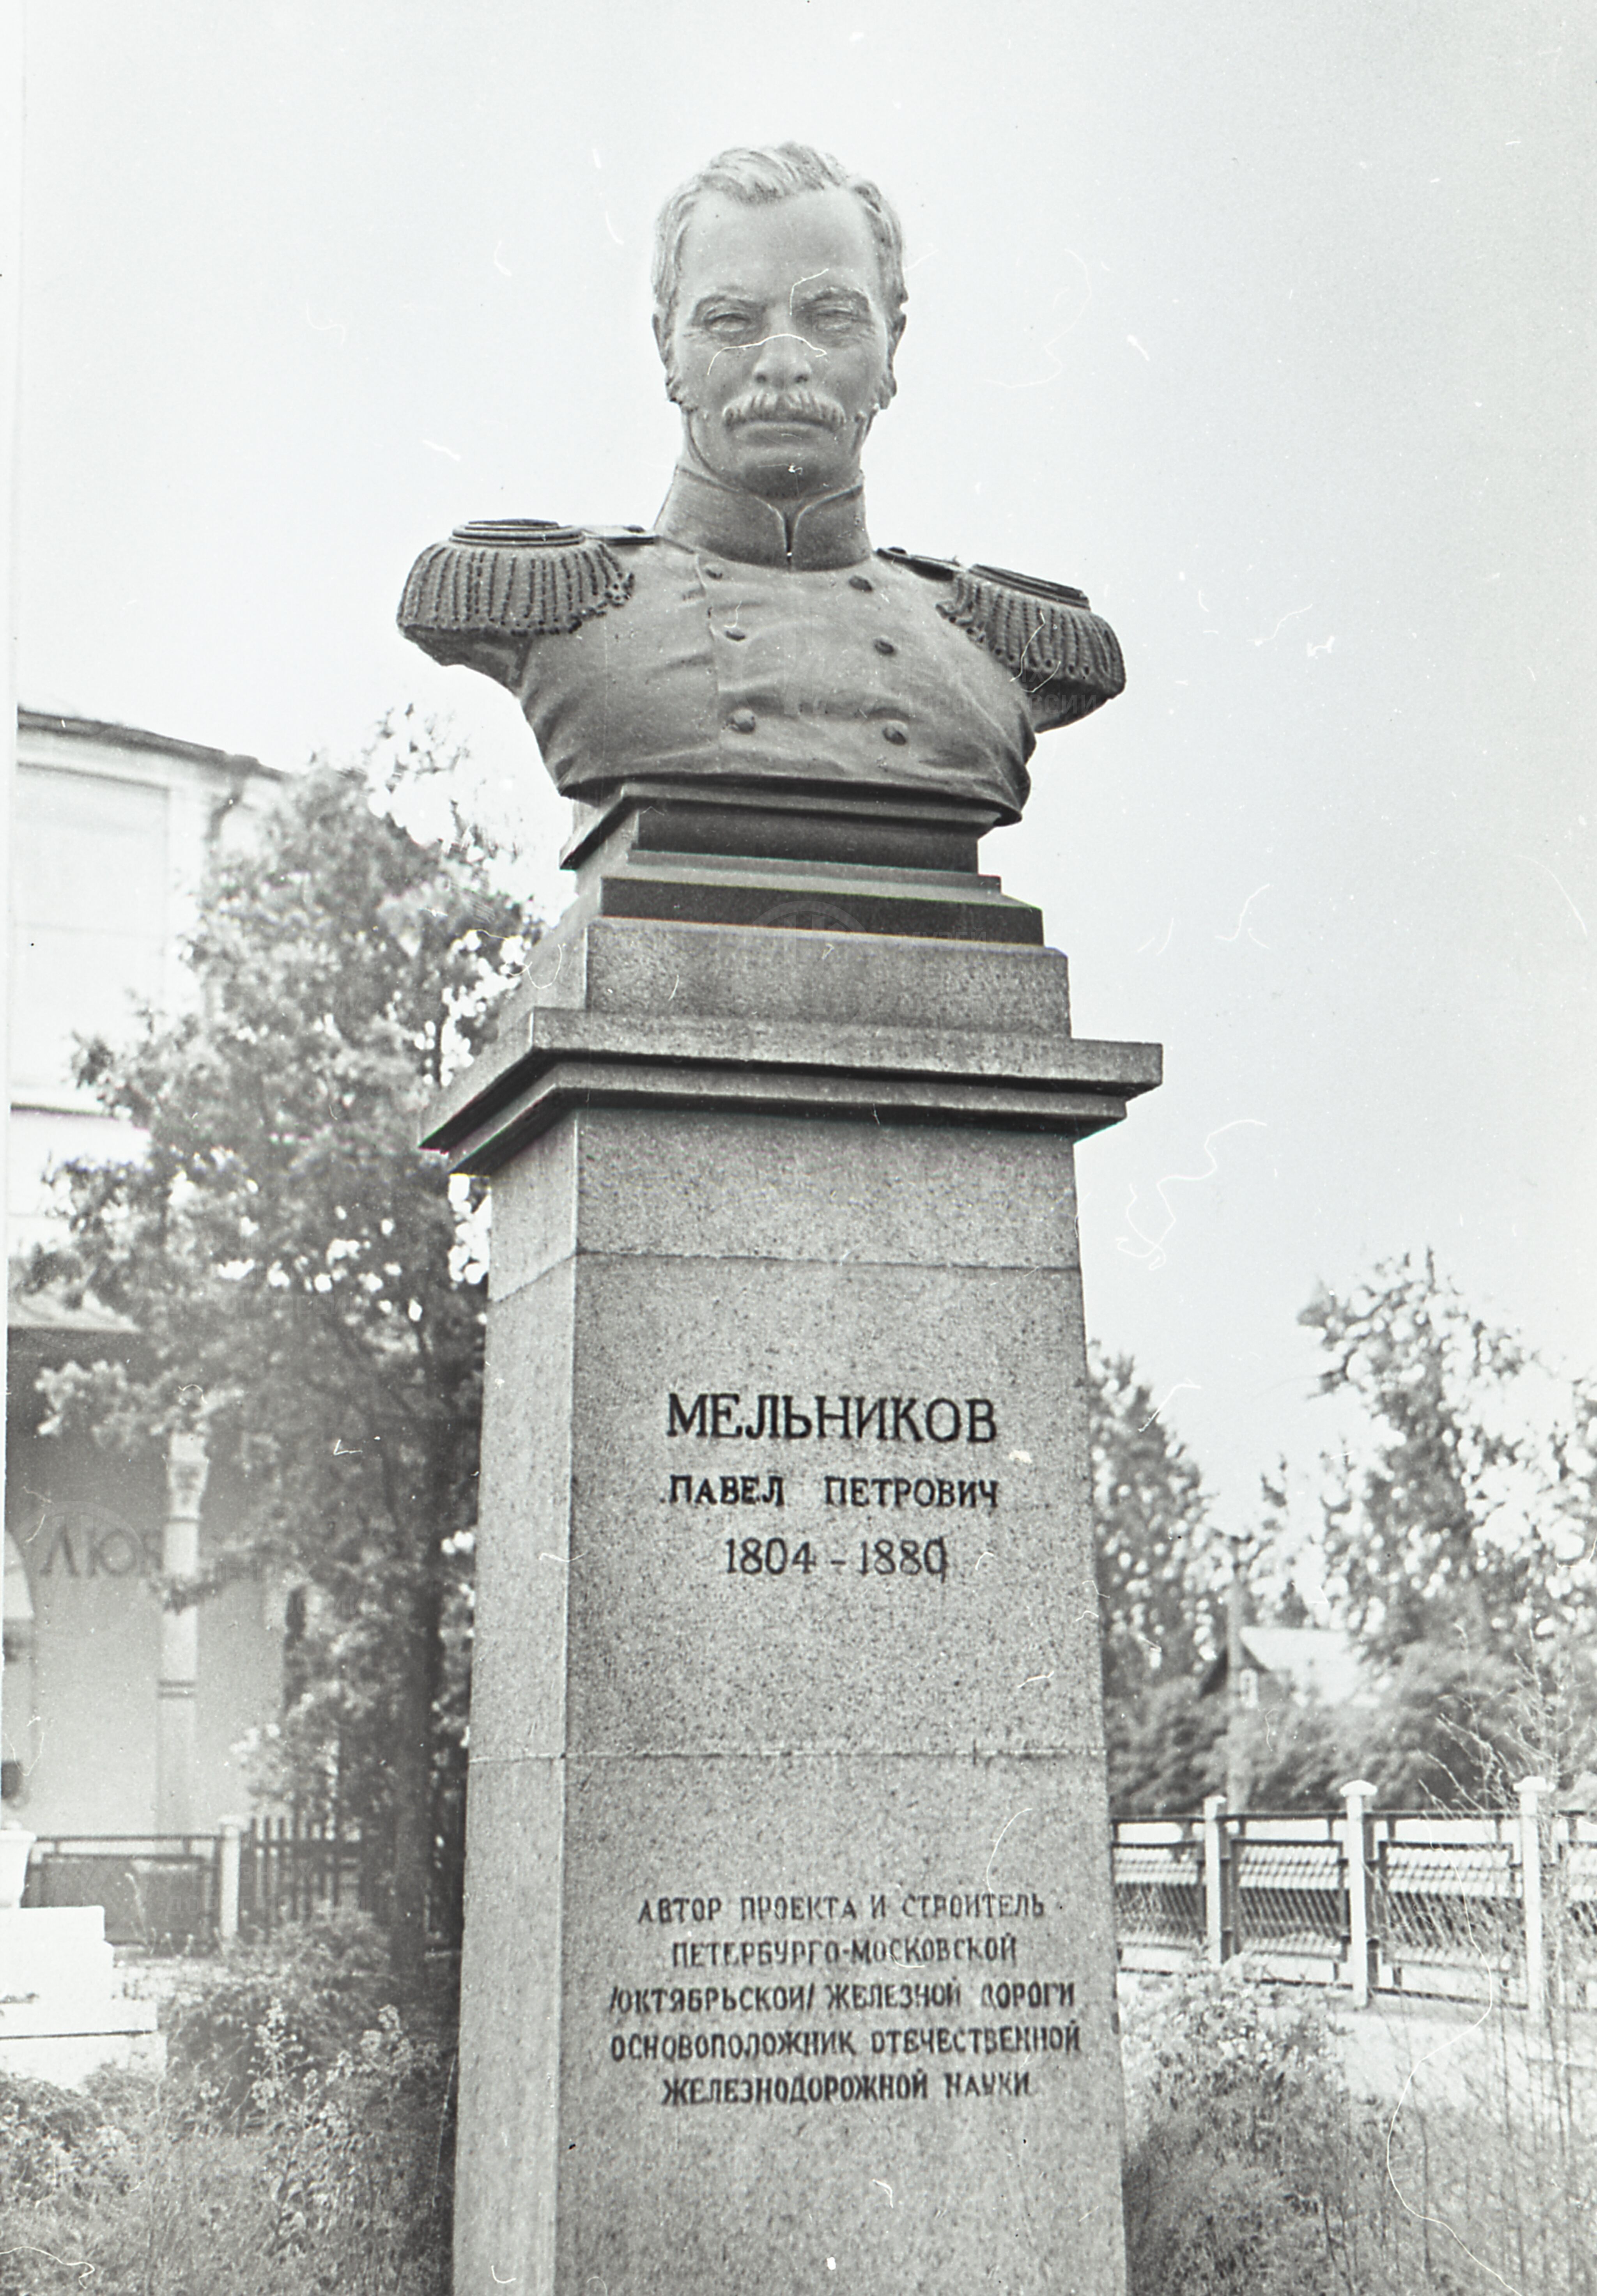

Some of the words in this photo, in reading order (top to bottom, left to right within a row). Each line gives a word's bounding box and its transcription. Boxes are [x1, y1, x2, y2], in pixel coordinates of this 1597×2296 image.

[666, 1392, 999, 1445] МЕЛЬНИКОВ
[668, 1474, 785, 1509] ПАВЕЛ
[823, 1475, 1000, 1508] ПЕТРОВИЧ
[725, 1537, 818, 1576] 1804
[857, 1535, 950, 1582] 1880
[637, 1896, 722, 1926] АВТОР
[740, 1895, 857, 1924] ПРОЕКТА
[870, 1894, 887, 1920] И
[901, 1892, 1045, 1920] СТРОИТЕЛЬ
[824, 1976, 961, 2011] ЖЕЛЕЗНОЙ
[981, 1980, 1075, 2010] ДОРОГИ
[610, 2029, 857, 2063] ОСНОВОПОЛОЖНИК
[871, 2019, 1082, 2056] ОТЕЧЕСТВЕННОЙ
[660, 2068, 928, 2105] ЖЕЛЕЗНОДОРОЖНОЙ
[943, 2071, 1031, 2100] НАУКИ
